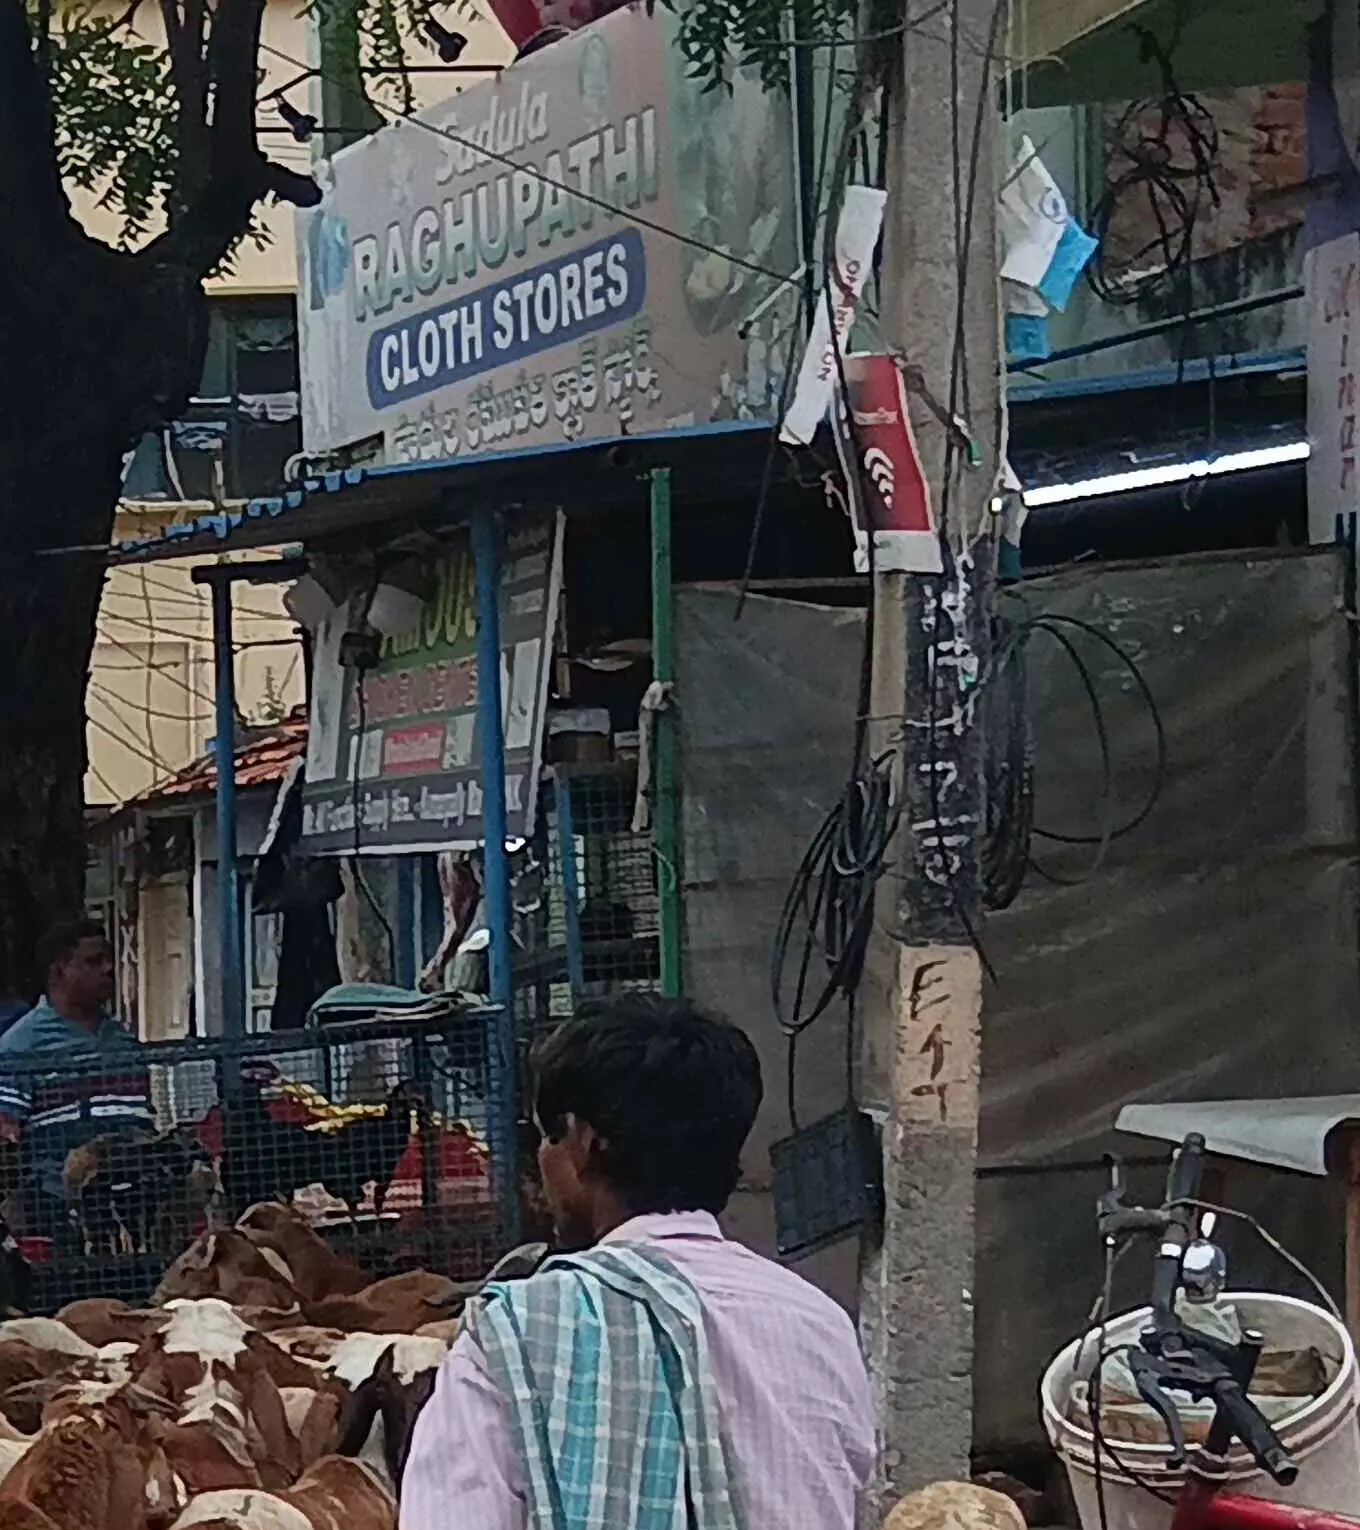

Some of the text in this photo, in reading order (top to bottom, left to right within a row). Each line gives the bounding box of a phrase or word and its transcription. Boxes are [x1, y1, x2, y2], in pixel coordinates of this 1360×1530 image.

[435, 82, 548, 187] Sadula
[351, 106, 659, 322] RAGHUPATHI
[379, 243, 629, 394] CLOTH STORES
